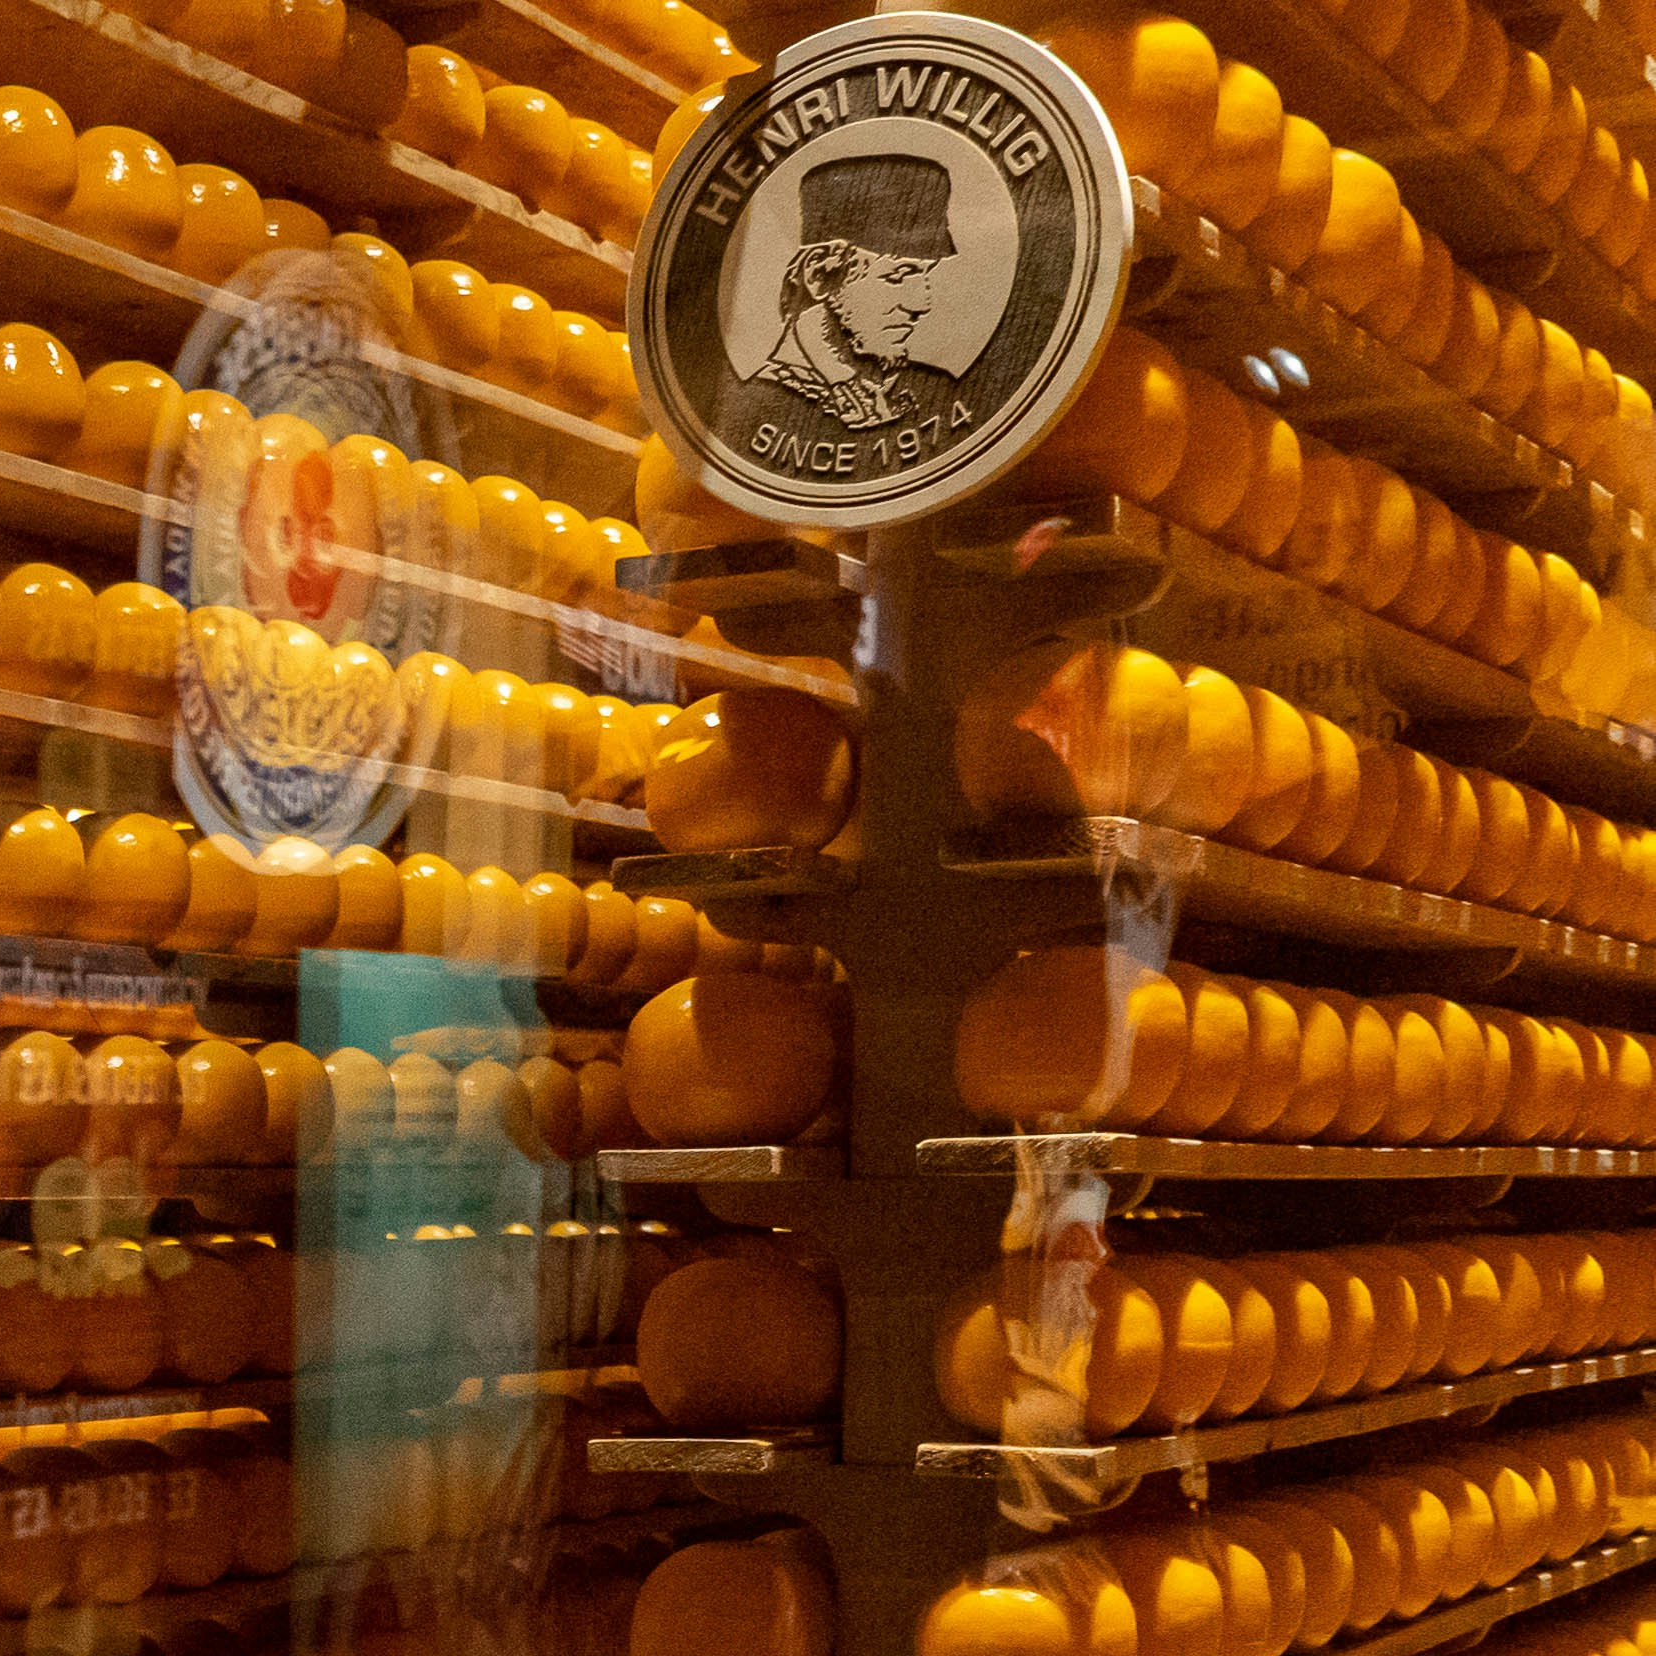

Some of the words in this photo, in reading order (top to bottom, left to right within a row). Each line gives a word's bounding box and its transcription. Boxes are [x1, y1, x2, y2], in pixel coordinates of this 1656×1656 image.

[696, 76, 849, 227] HENRI
[875, 65, 1050, 178] WILLIG
[749, 422, 857, 474] SINCE
[872, 398, 976, 468] 1974
